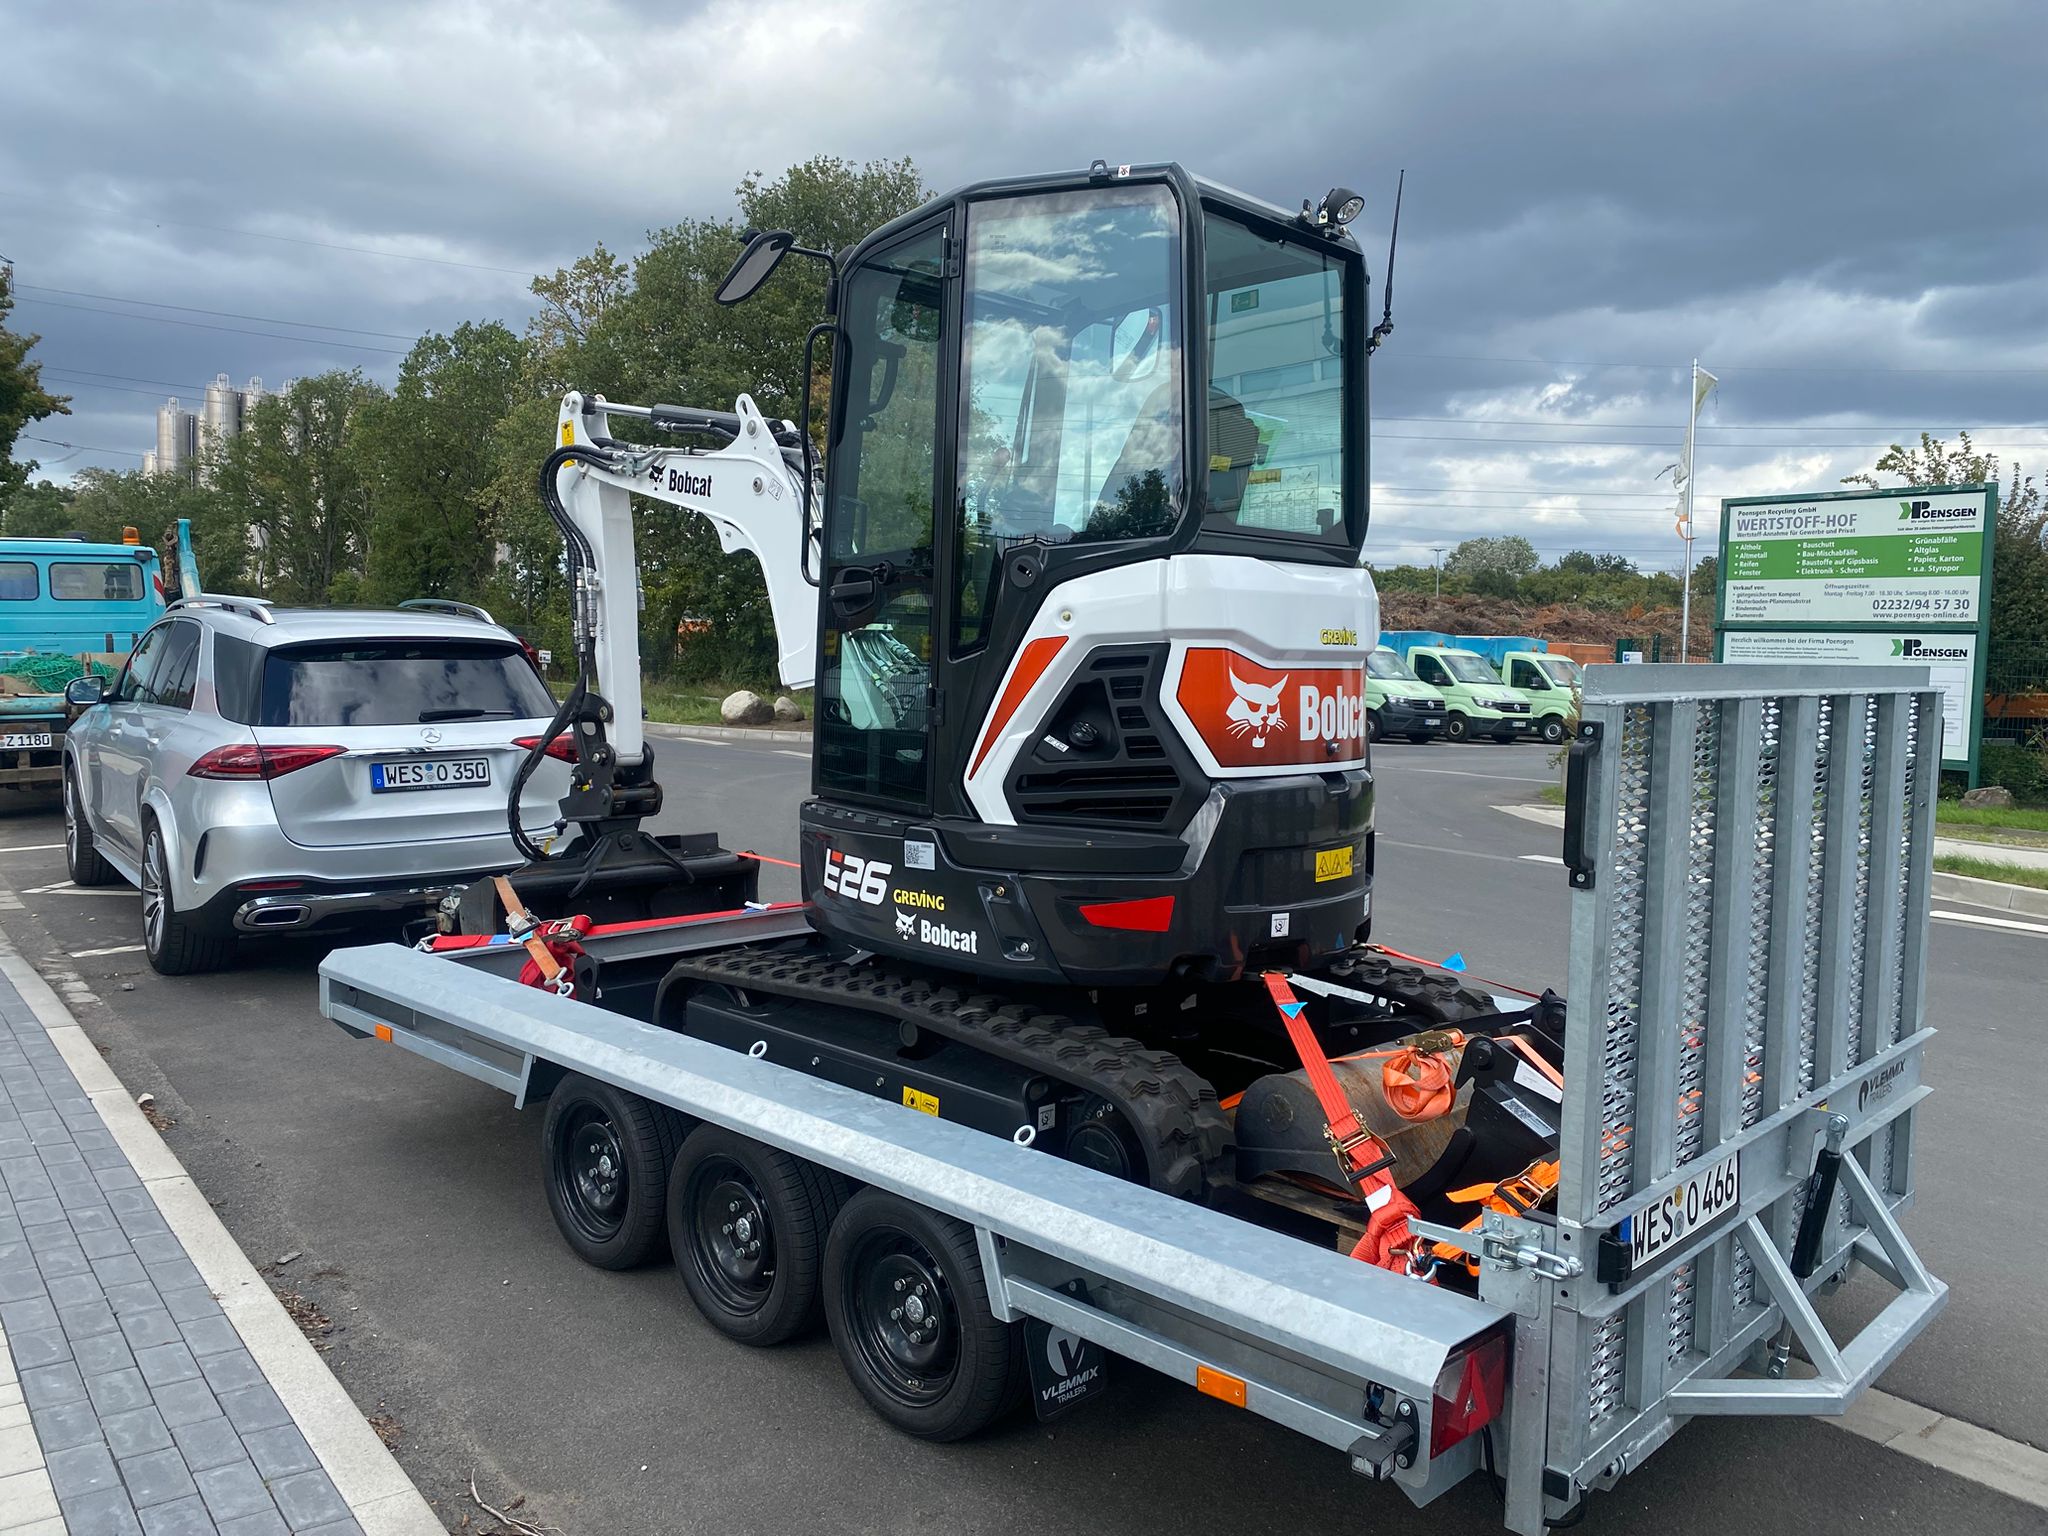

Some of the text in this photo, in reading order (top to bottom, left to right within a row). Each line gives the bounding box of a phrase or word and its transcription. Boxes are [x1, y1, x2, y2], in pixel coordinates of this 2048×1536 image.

[669, 469, 712, 497] Bobcat
[1768, 508, 1796, 516] Recycling
[1911, 501, 1976, 519] POENSGEN
[1737, 514, 1858, 531] WERTSTOFF-HOF
[1915, 536, 1958, 544] Grünabfälle
[1802, 550, 1858, 558] Bau-Mischabfälle
[1914, 546, 1939, 554] Altglas
[1740, 560, 1759, 568] Reifen
[1802, 558, 1833, 566] Baustoffe
[1847, 557, 1879, 565] Gipsbasis
[1914, 556, 1938, 564] Papier,
[1801, 567, 1834, 575] Elektronik
[1840, 566, 1864, 574] Schrott
[1928, 565, 1960, 573] Styropor
[1872, 599, 1970, 610] 02232/94 57 30
[1903, 639, 1968, 658] POENSGEN
[6, 734, 50, 746] Z 1180
[386, 762, 486, 784] WES O 350
[824, 848, 892, 906] E26
[893, 888, 945, 910] GREVING
[920, 919, 977, 954] Bobcat
[1869, 1058, 1906, 1092] VLEMMIX
[1870, 1081, 1893, 1104] TRAILERS
[1633, 1158, 1734, 1262] WES O 466
[1042, 1365, 1099, 1401] VLEMMIX
[1057, 1384, 1087, 1404] TRAILERS
